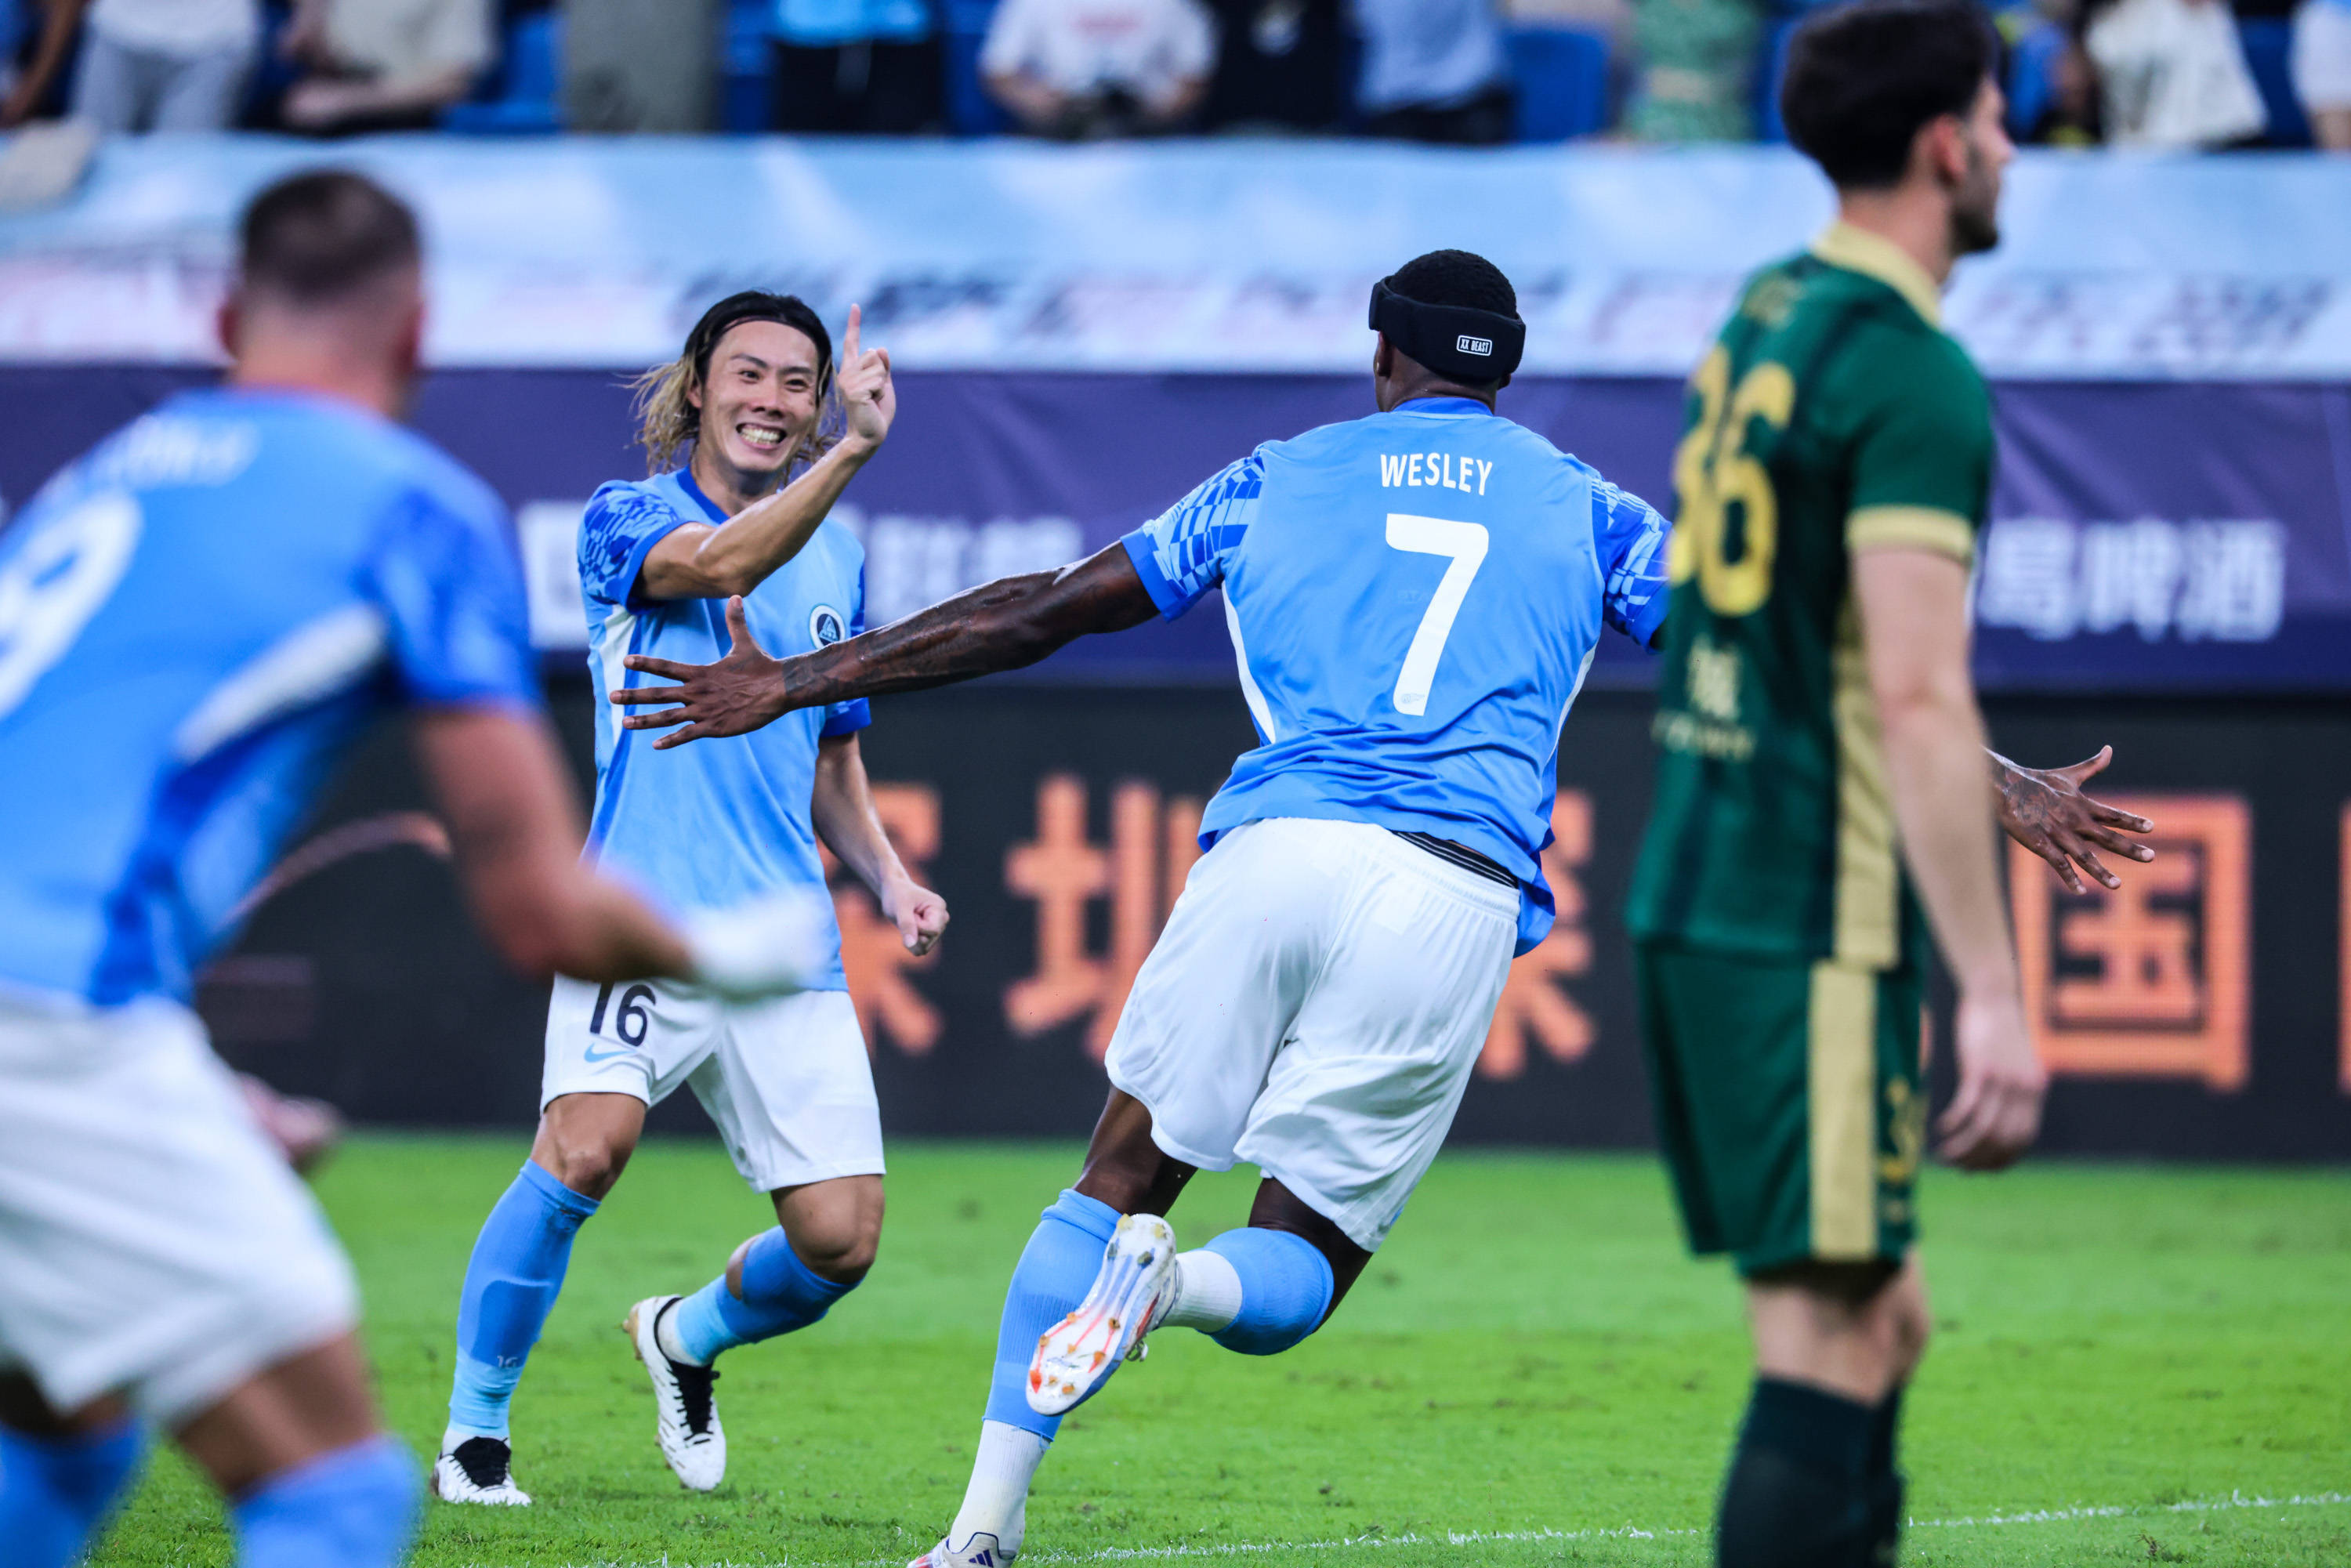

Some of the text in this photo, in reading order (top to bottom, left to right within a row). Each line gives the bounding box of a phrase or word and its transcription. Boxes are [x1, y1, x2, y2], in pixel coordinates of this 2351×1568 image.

[1471, 340, 1489, 353] BEAST
[1380, 452, 1492, 496] WESLEY
[1386, 513, 1489, 716] 7
[589, 980, 657, 1047] 16
